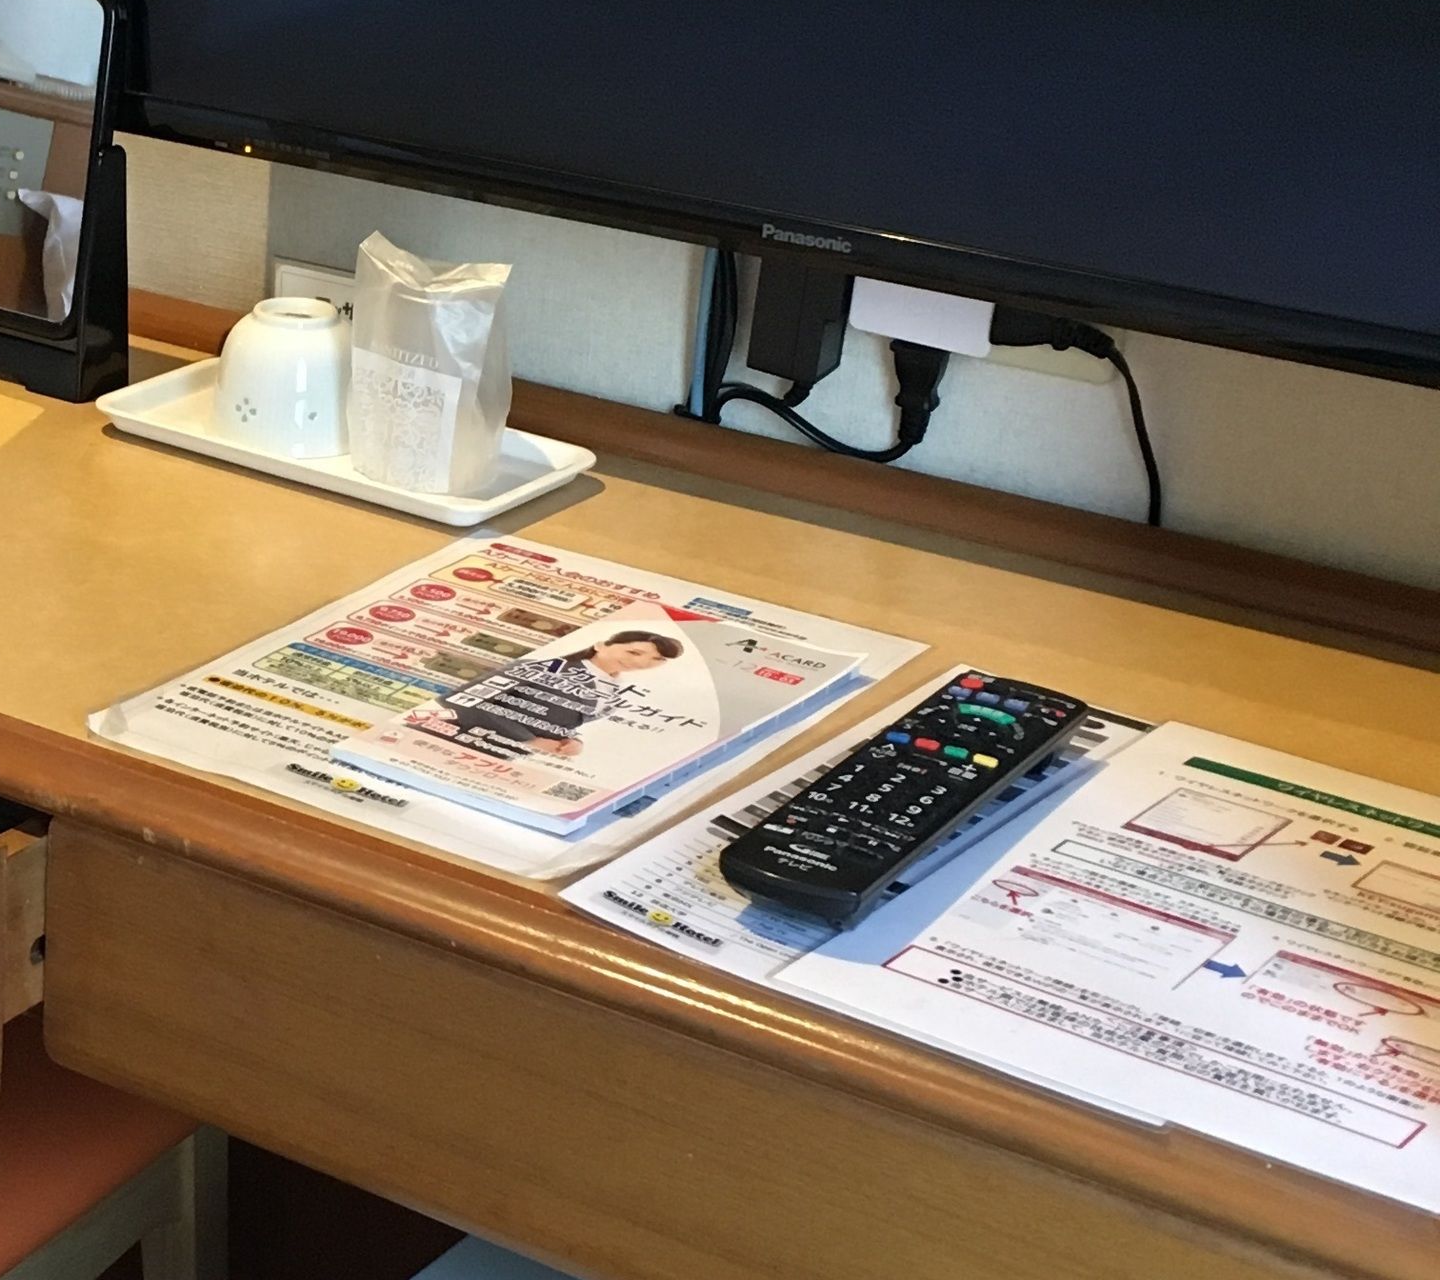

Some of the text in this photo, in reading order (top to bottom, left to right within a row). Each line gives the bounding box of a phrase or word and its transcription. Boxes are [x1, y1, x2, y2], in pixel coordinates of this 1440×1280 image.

[761, 223, 852, 254] Panasonic
[770, 652, 827, 670] ACARD
[519, 658, 652, 699] Aカード
[505, 664, 709, 730] 加盟ホテルガイド
[854, 764, 866, 773] 1
[838, 774, 855, 783] 4
[890, 773, 907, 783] 2
[286, 762, 334, 783] Smile
[357, 786, 410, 808] Hotel
[826, 783, 843, 791] 7
[878, 783, 895, 793] 5
[930, 785, 948, 795] 3
[865, 793, 883, 802] 8
[919, 796, 935, 805] 6
[906, 805, 923, 815] 9
[763, 845, 839, 872] Panasonic
[777, 857, 813, 871] テレビ
[602, 889, 649, 916] Smile
[670, 920, 724, 948] Hotel
